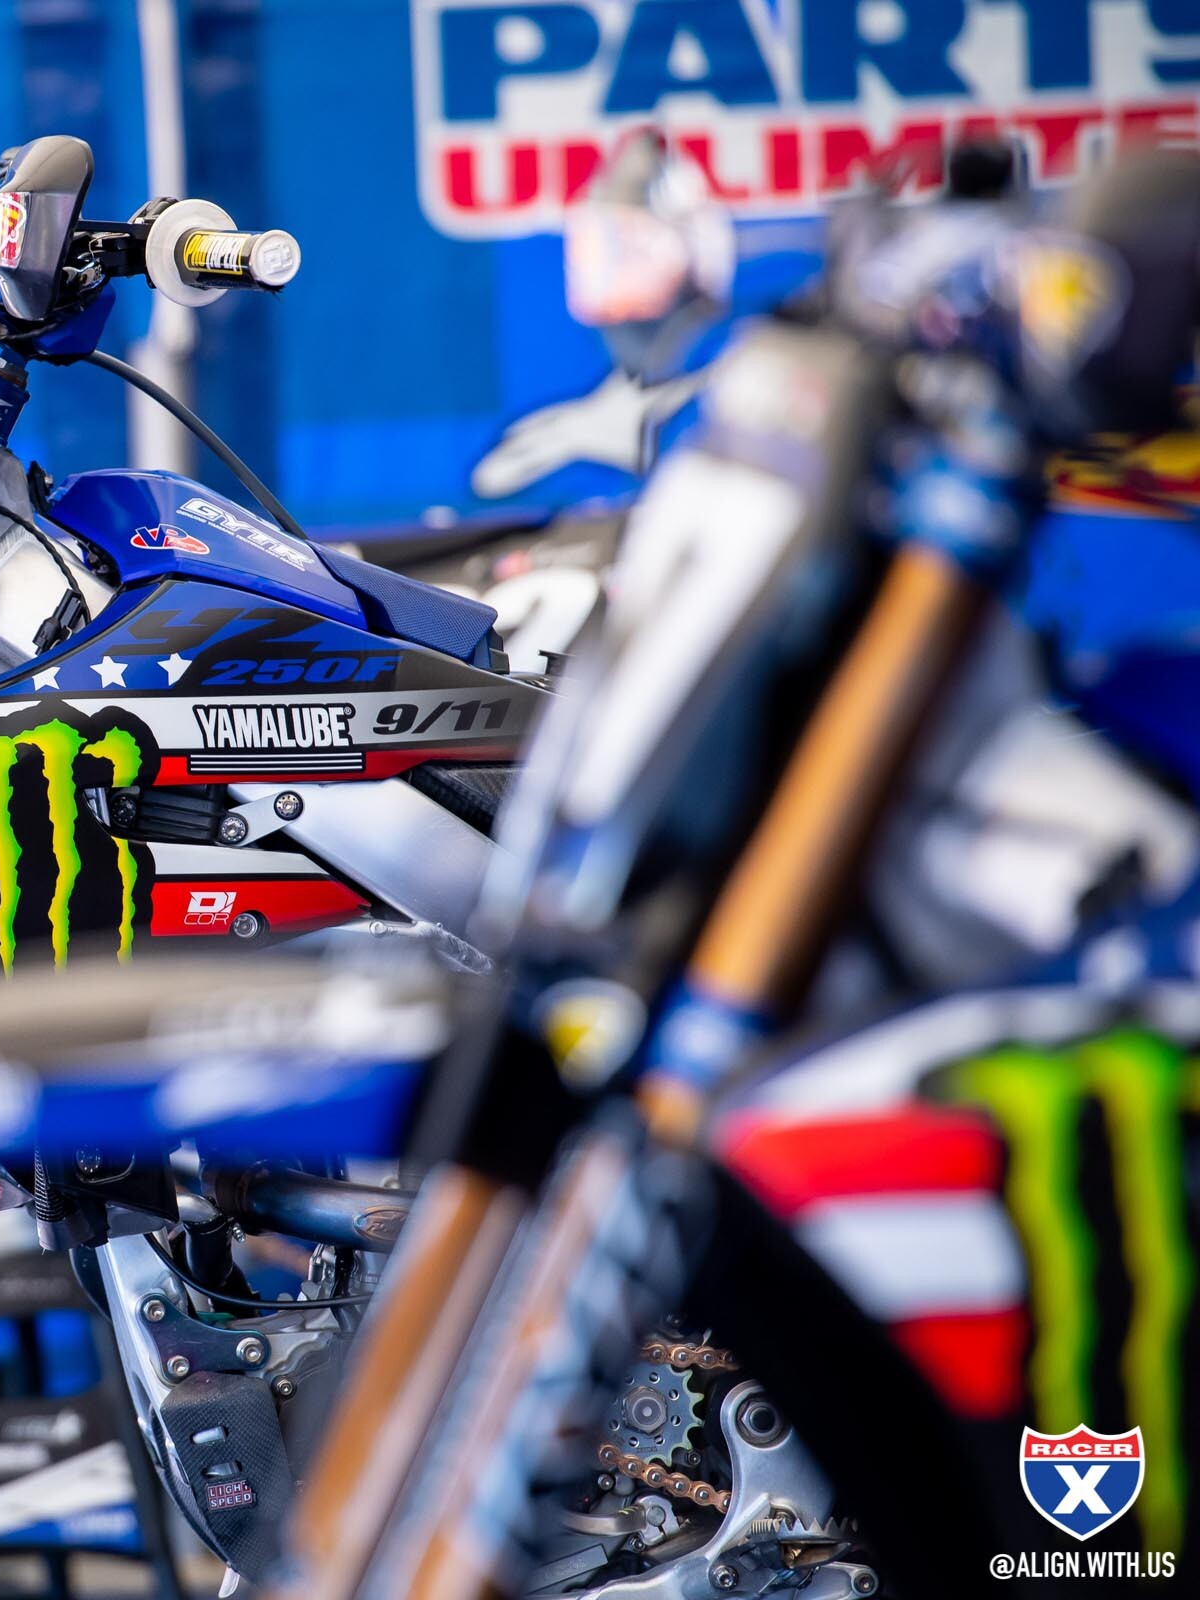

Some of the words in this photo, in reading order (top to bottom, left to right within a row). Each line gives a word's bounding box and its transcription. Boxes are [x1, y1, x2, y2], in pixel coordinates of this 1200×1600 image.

[135, 524, 188, 548] VP
[179, 497, 315, 567] GYTR
[200, 656, 403, 686] 250F
[196, 706, 350, 748] YAMALUBE
[373, 699, 514, 735] 9/11
[210, 1493, 251, 1508] SPEED
